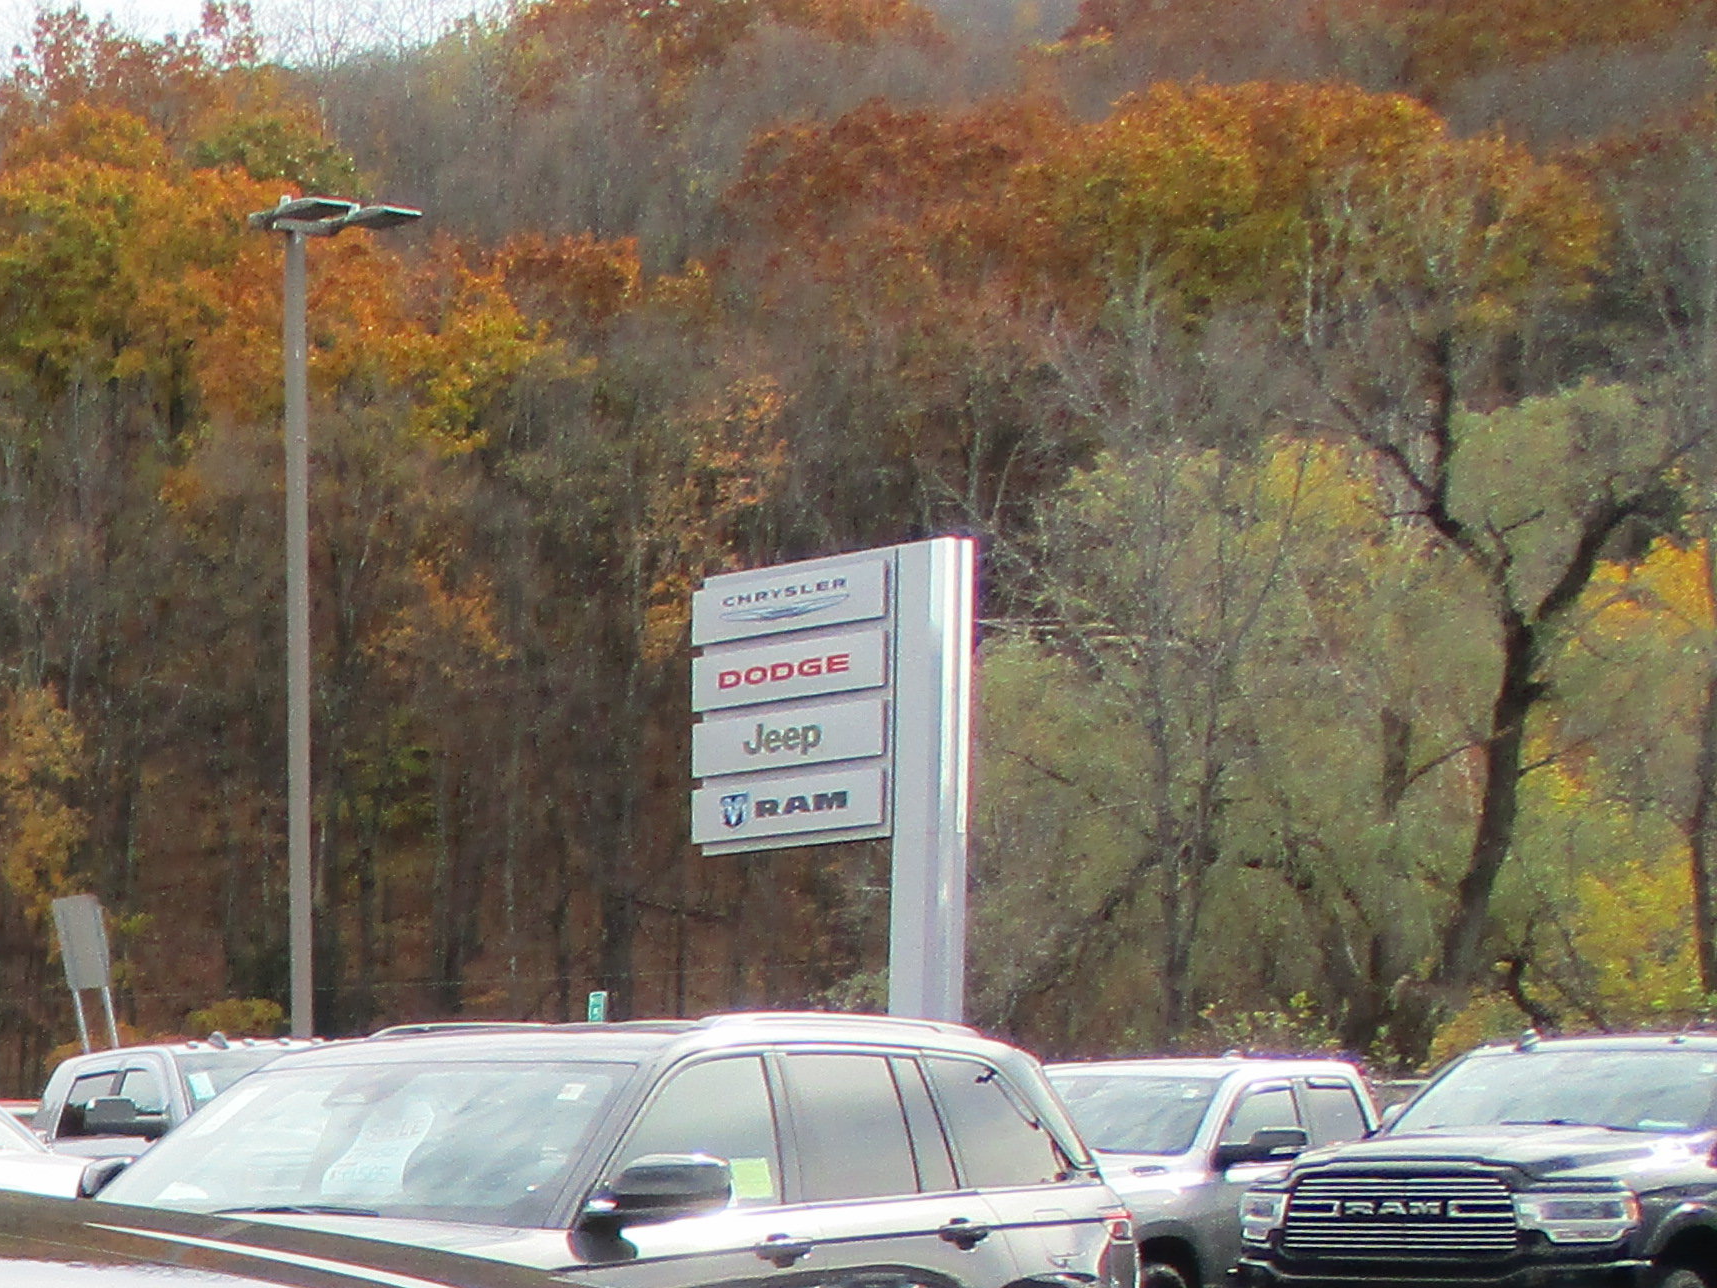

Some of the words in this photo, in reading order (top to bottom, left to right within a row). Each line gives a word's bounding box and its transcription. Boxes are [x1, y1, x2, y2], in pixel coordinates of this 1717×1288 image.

[721, 578, 847, 607] CHRYSLER
[717, 653, 850, 690] DODGE
[742, 724, 822, 756] Jeep
[754, 790, 848, 818] RAM
[1344, 1201, 1442, 1215] RAM
